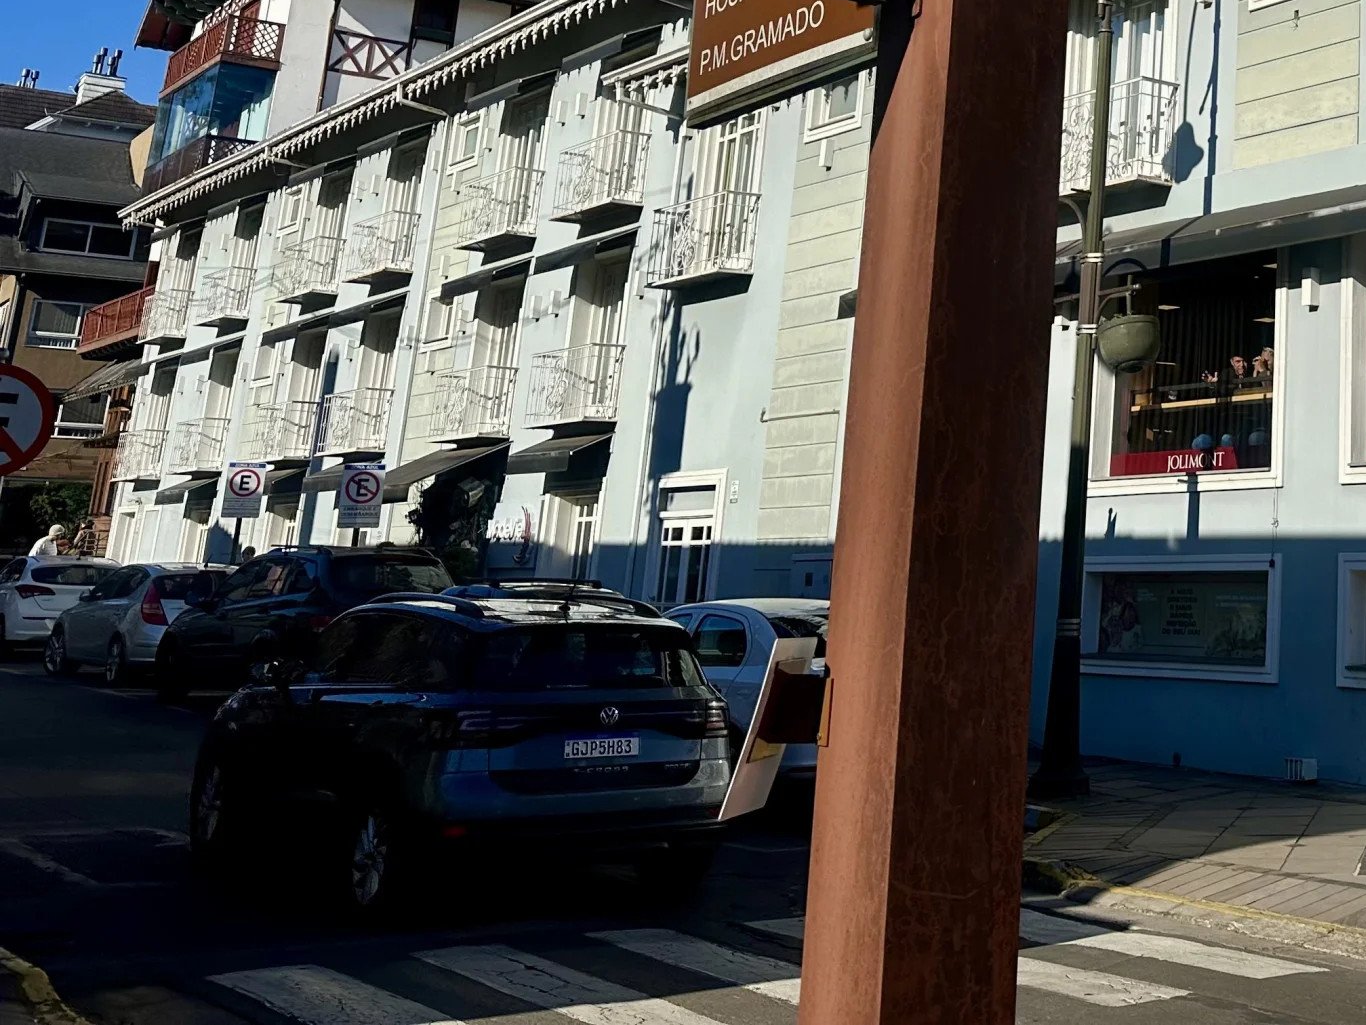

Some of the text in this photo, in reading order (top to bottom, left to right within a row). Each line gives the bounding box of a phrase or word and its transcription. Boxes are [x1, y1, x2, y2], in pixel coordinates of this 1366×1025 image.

[700, 0, 825, 76] P.M.GRAMADO
[1167, 452, 1225, 472] JOLIMONT
[238, 475, 252, 491] E
[571, 739, 632, 756] GJP5H83
